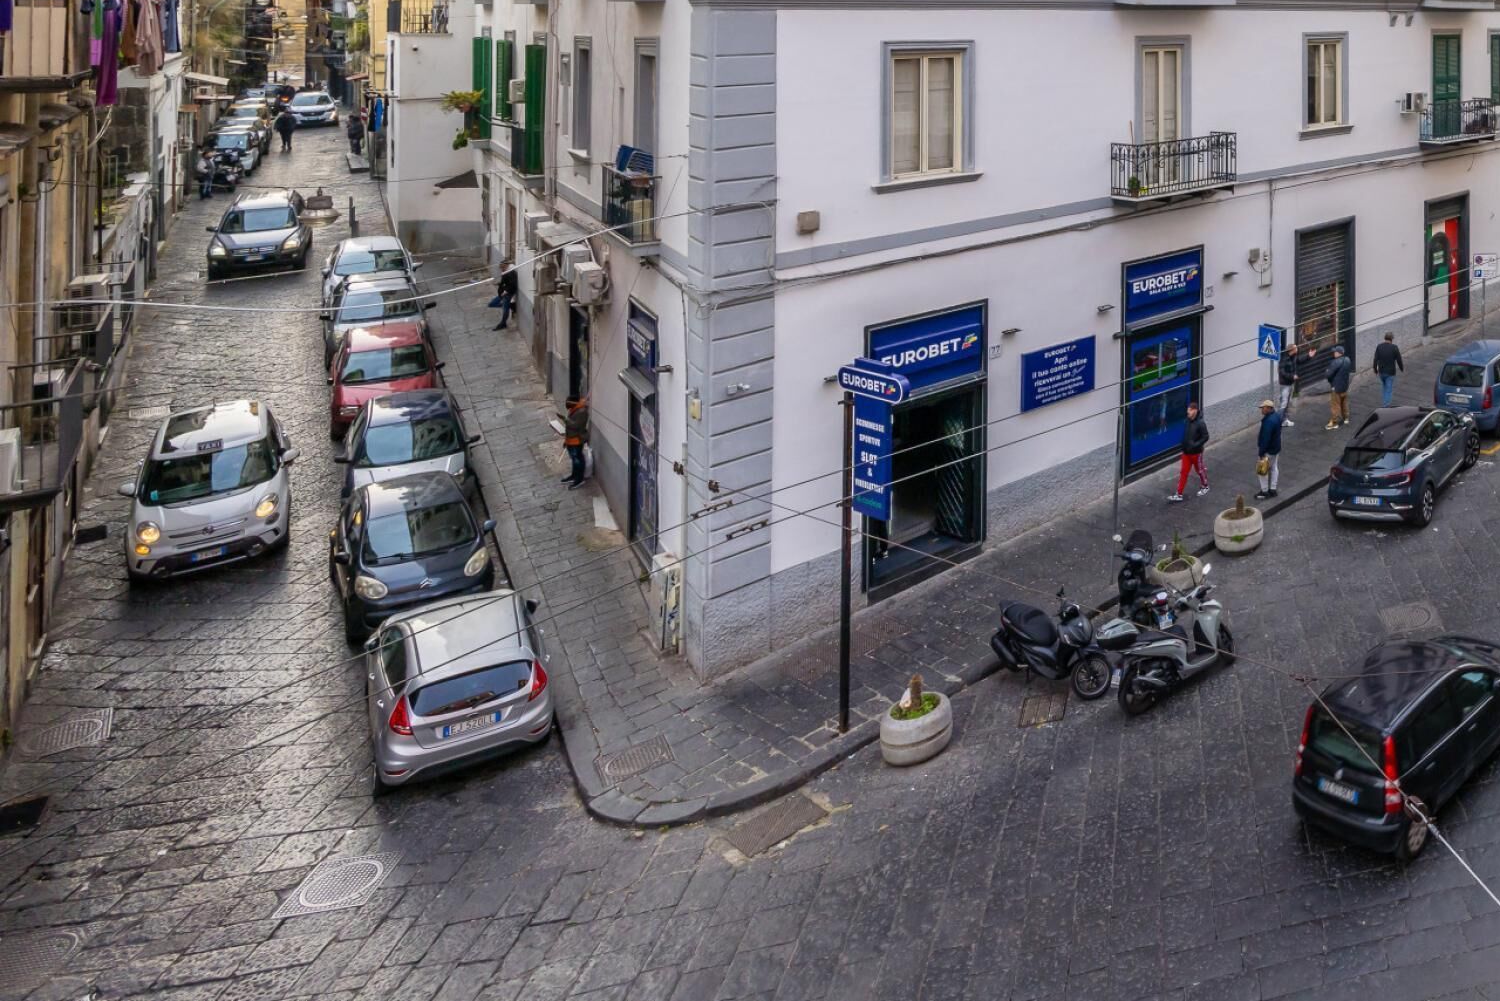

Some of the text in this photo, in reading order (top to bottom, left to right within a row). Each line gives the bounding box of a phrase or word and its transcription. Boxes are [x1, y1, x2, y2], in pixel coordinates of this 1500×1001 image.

[1133, 271, 1187, 294] EUROBET
[881, 337, 962, 368] EUROBET
[1044, 345, 1071, 358] EUROBET
[1054, 355, 1068, 365] Apri
[842, 372, 887, 394] EUROBET
[200, 440, 222, 451] TAXI
[860, 450, 878, 466] SLOT
